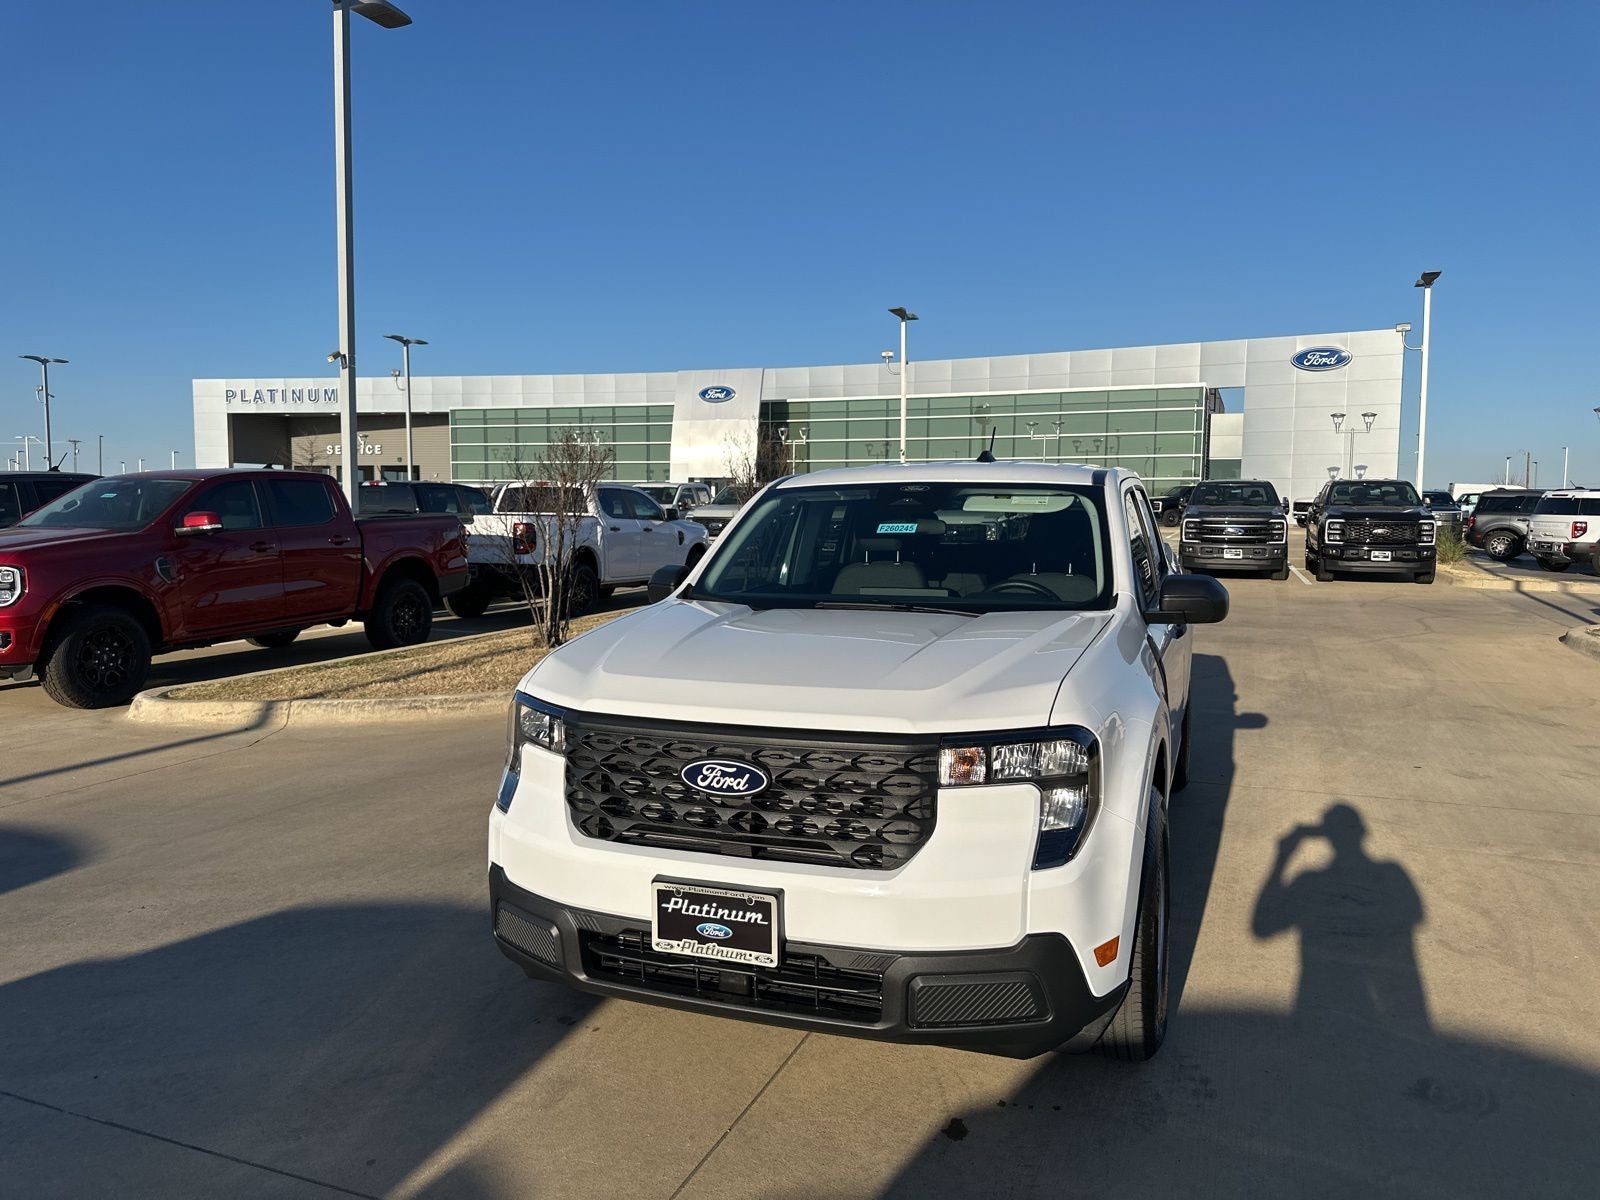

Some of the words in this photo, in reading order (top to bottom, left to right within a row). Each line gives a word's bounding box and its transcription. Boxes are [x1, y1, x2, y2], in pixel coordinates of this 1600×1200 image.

[1303, 351, 1339, 366] Ford
[225, 388, 338, 404] PLATINUM
[326, 444, 382, 455] SEICE
[697, 764, 750, 791] Ford
[661, 897, 769, 925] Platinum
[681, 941, 752, 961] Platinum
